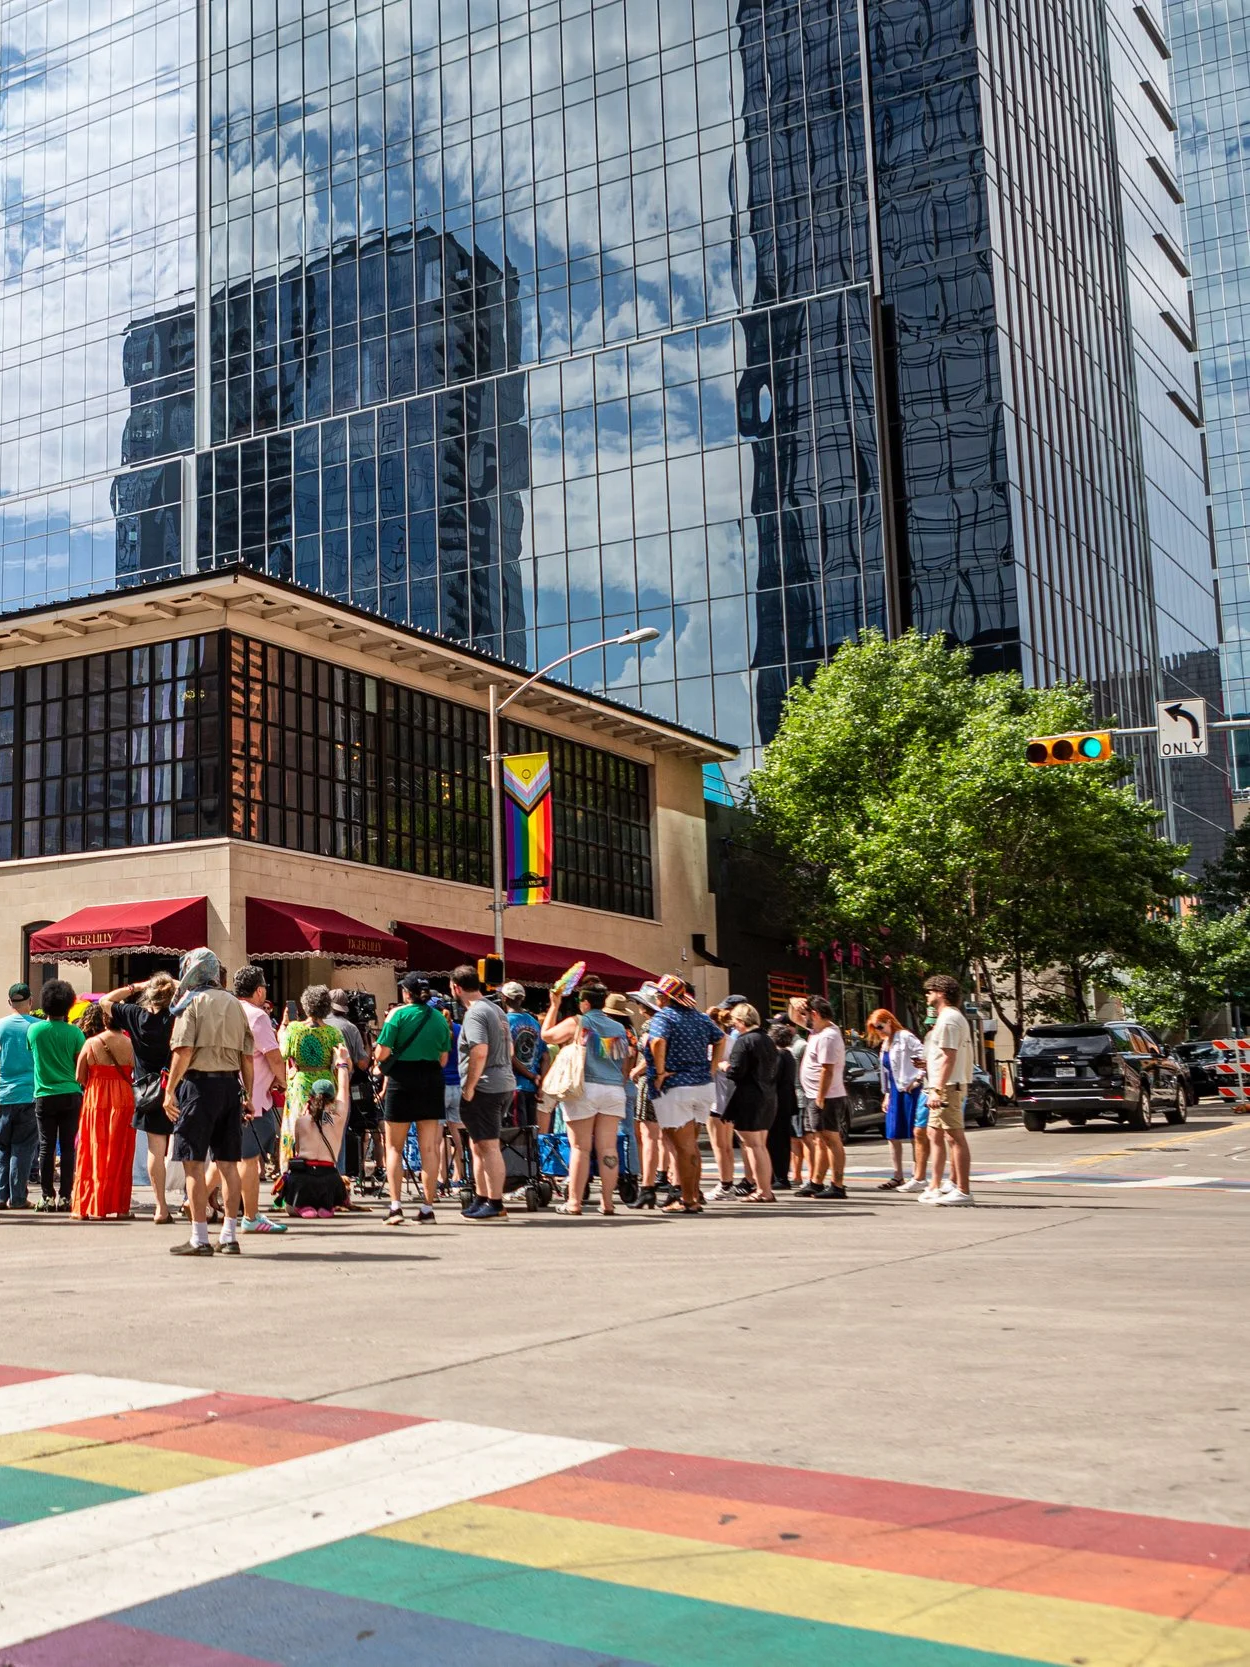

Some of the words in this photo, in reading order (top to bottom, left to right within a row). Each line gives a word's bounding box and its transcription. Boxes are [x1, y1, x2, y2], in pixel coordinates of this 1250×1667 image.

[1162, 741, 1203, 755] ONLY
[65, 934, 91, 946] TIGER
[92, 932, 113, 945] LILLY
